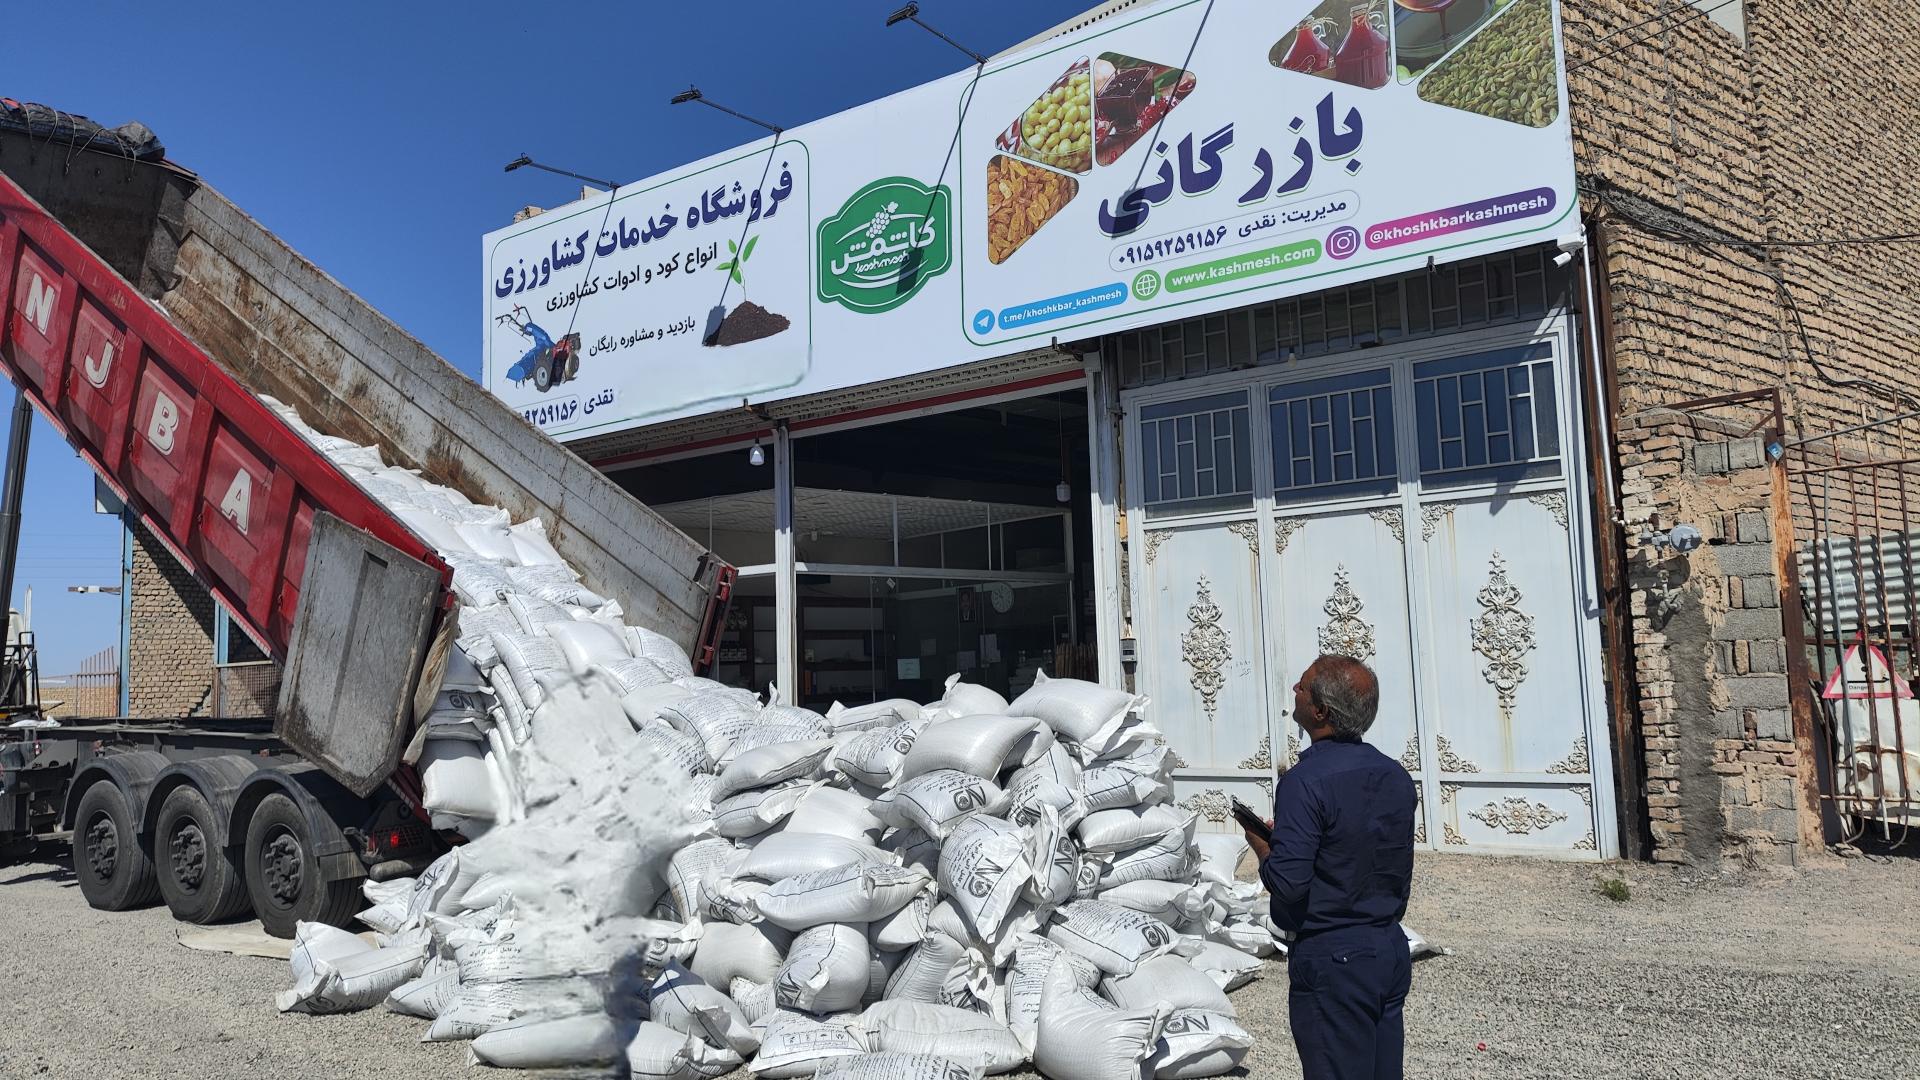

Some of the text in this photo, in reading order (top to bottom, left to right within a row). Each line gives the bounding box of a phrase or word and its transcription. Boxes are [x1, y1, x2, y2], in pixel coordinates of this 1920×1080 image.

[1098, 91, 1364, 236] بازرگانی
[495, 161, 793, 298] فروشگاه خدمات کشاورزی
[1239, 214, 1276, 237] نقدی
[1281, 201, 1346, 224] مدیریت:
[1370, 195, 1548, 244] @khoshkbarkashmesh
[546, 242, 717, 311] انواع کود و ادوات کشاورزی
[1172, 245, 1316, 287] www.kashmesh.com
[1003, 288, 1122, 323] t.me/khoshkbar_kashmesh
[589, 315, 696, 356] بازدید و مشاوره رایگان
[25, 273, 252, 535] N J B A
[583, 388, 614, 414] نقدی
